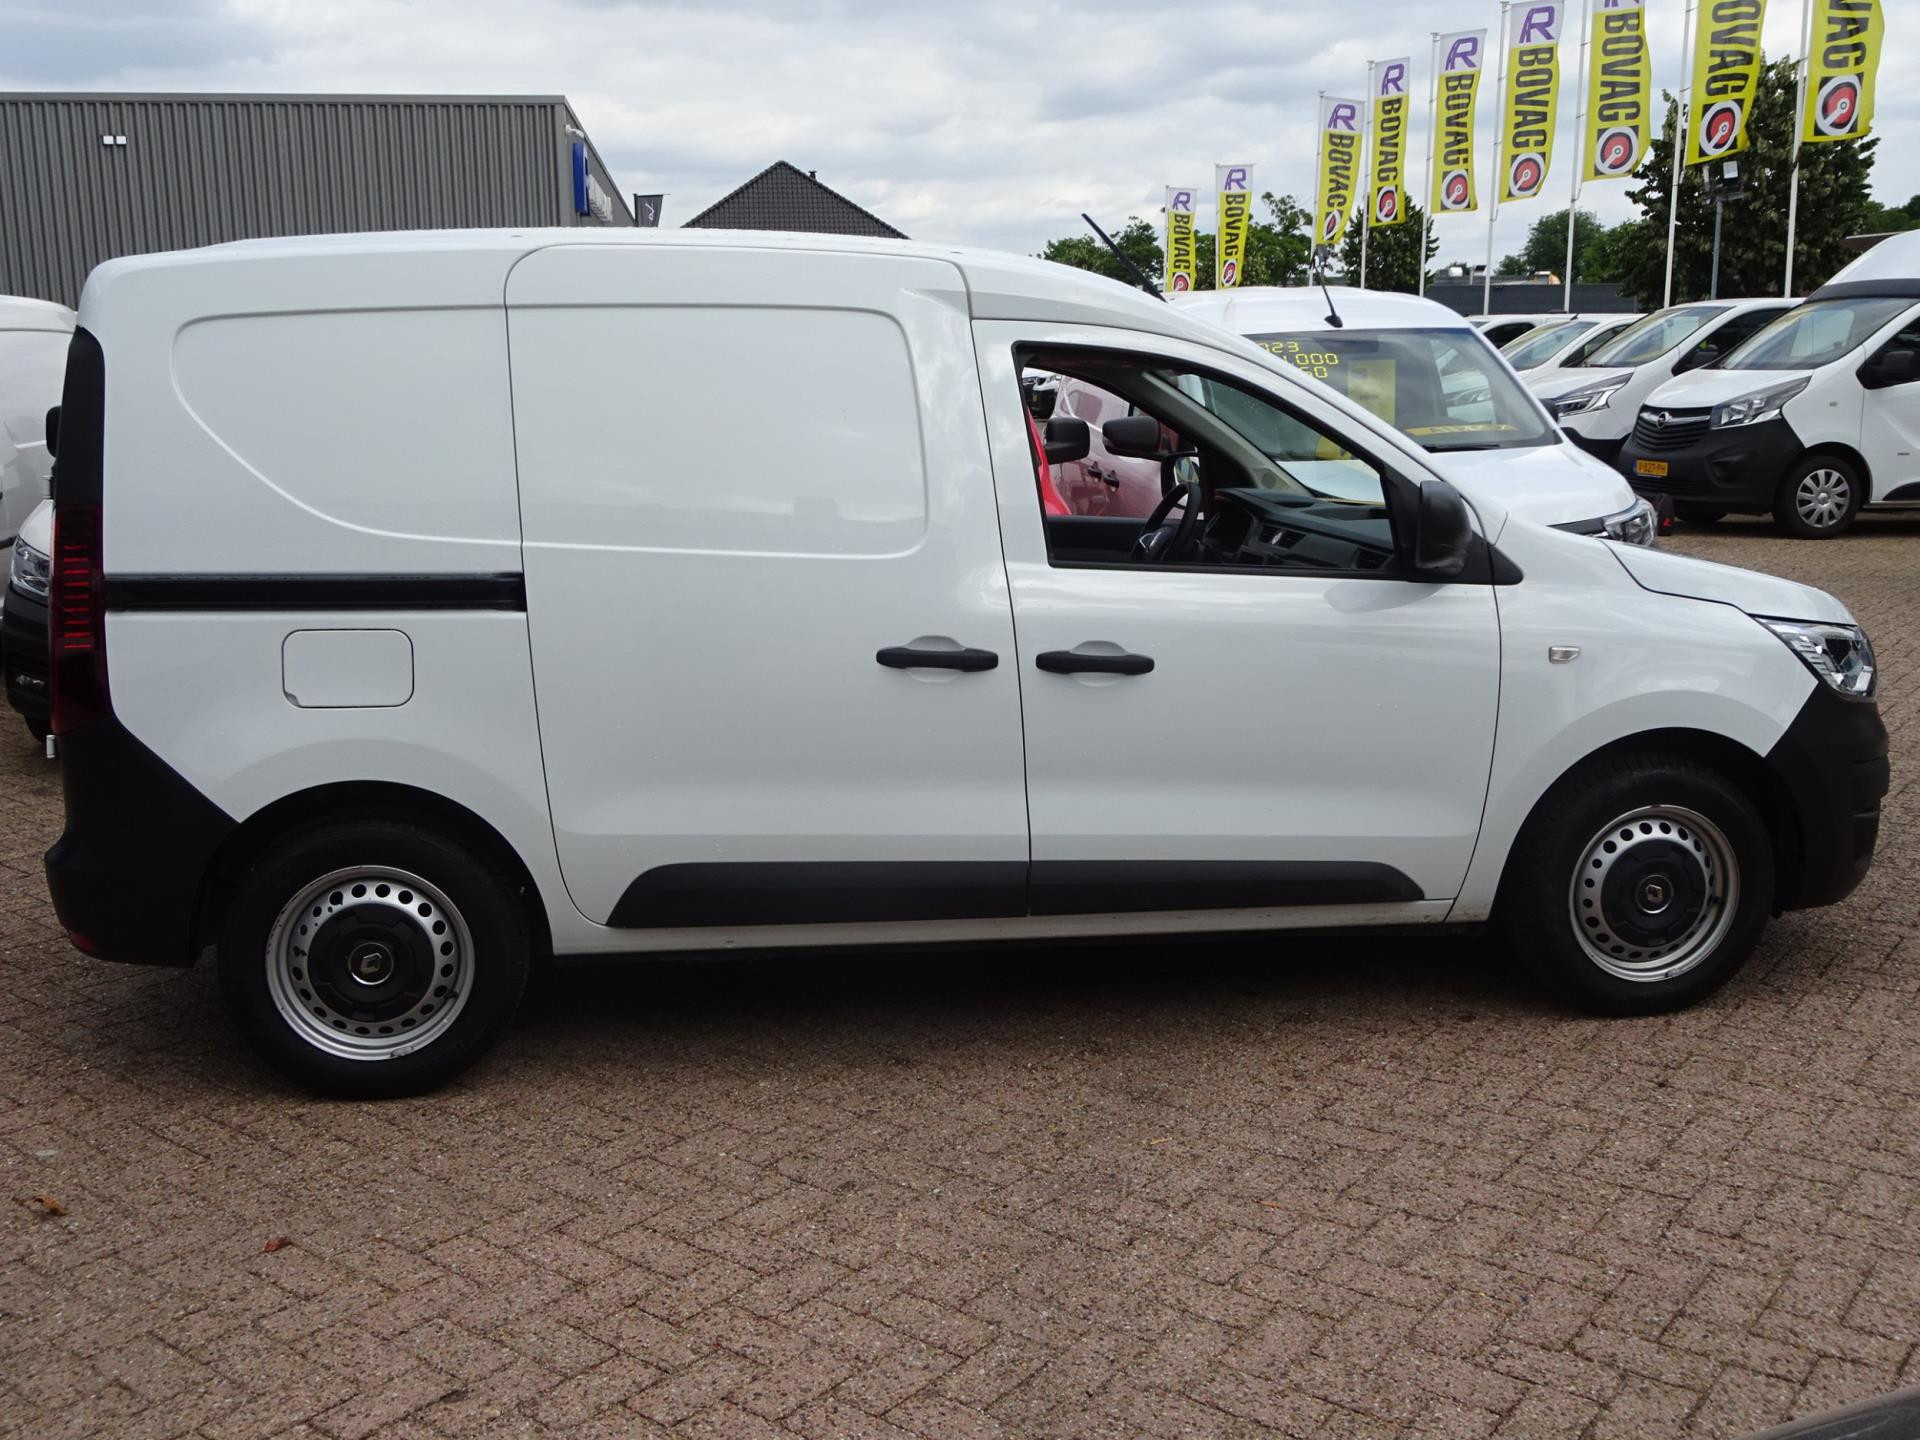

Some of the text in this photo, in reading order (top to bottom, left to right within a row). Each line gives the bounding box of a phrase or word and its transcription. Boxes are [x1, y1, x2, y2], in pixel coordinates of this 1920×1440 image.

[1445, 36, 1478, 71] R
[1519, 6, 1555, 43] R
[1705, 0, 1762, 97] OVAG
[1381, 63, 1405, 95] R
[1512, 47, 1554, 149] BOVAG
[1598, 12, 1643, 122] BOVAG
[1328, 103, 1356, 131] R
[1377, 98, 1402, 182] BOVAG
[1443, 74, 1475, 166] BOVAG
[1224, 168, 1247, 190] R
[1327, 133, 1355, 208] BOVAG
[1173, 214, 1192, 270] BOVAG
[1224, 193, 1246, 257] BOVAG
